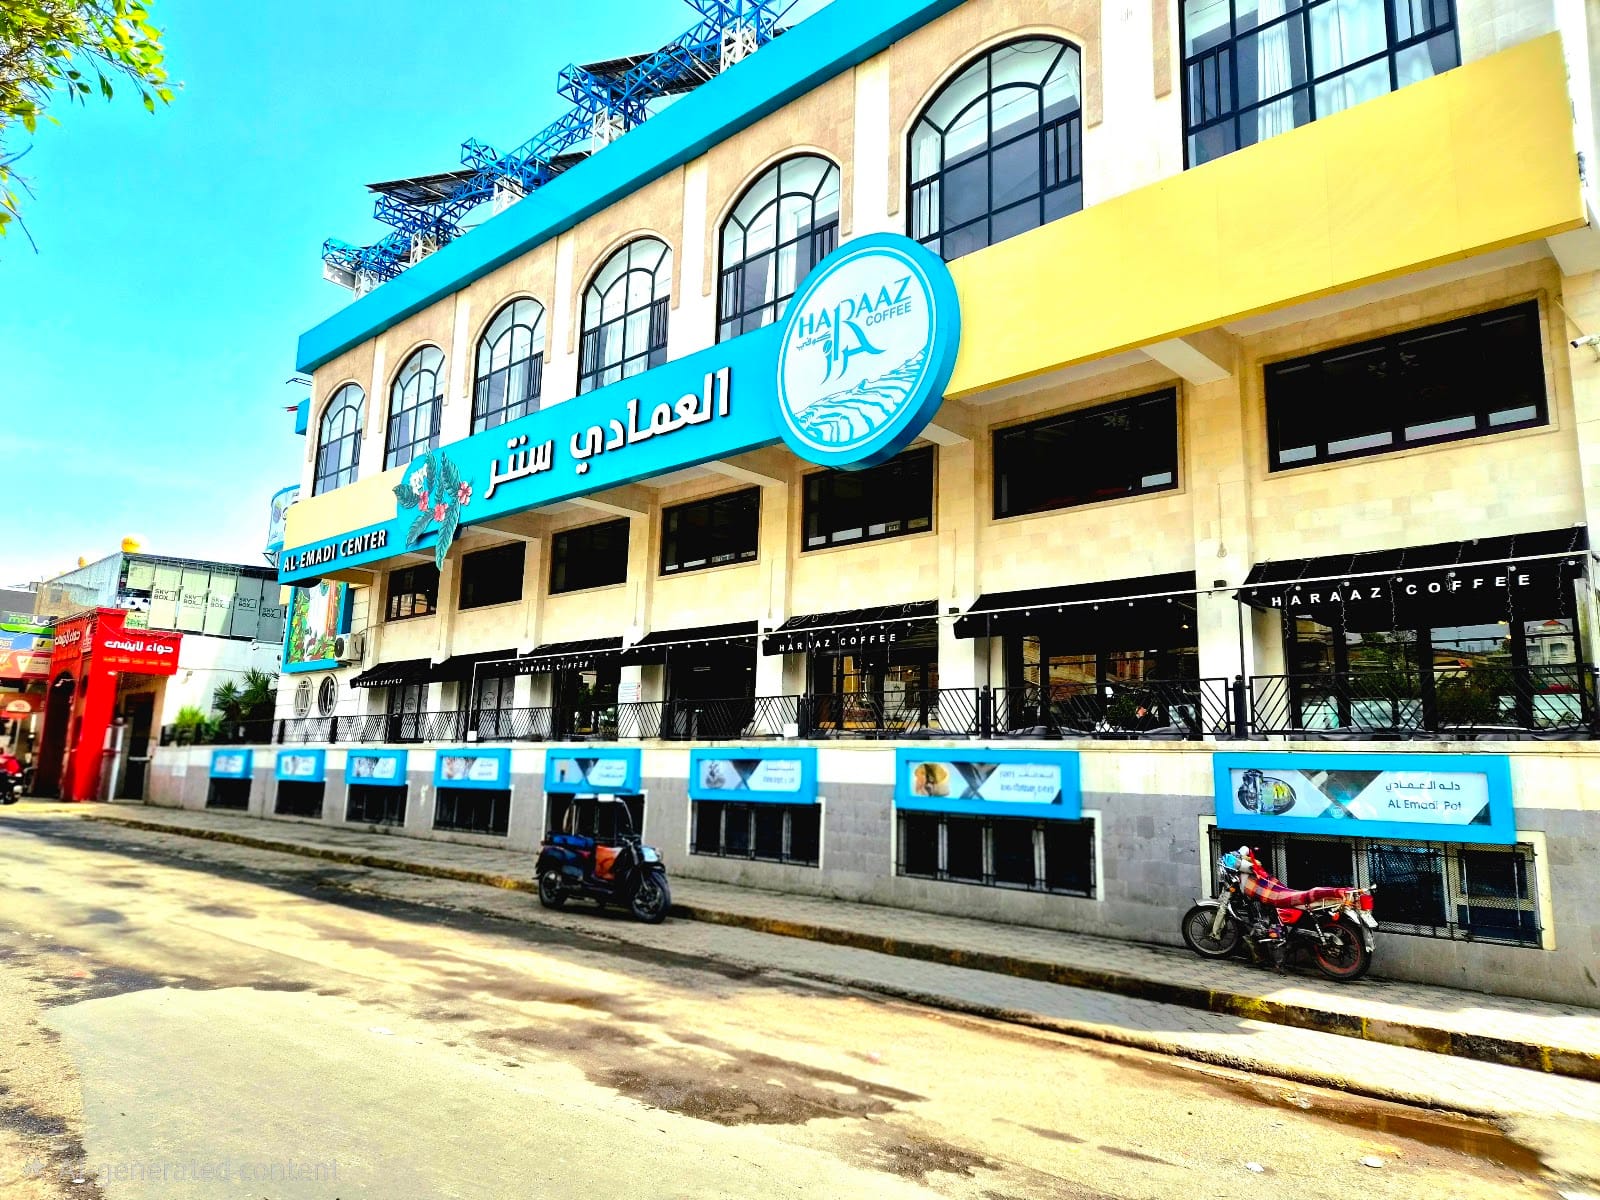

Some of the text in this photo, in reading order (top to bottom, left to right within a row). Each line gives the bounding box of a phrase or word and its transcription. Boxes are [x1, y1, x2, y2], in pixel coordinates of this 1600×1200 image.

[798, 275, 912, 361] HARAAZ
[865, 301, 912, 327] COFFEE
[484, 366, 732, 499] العمادي سنتر
[282, 529, 387, 572] AL-EMADI CENTER
[1270, 574, 1531, 607] HARAAZ COFFEE
[145, 642, 174, 655] حواء
[1388, 799, 1402, 809] AL
[1443, 801, 1462, 811] Pot
